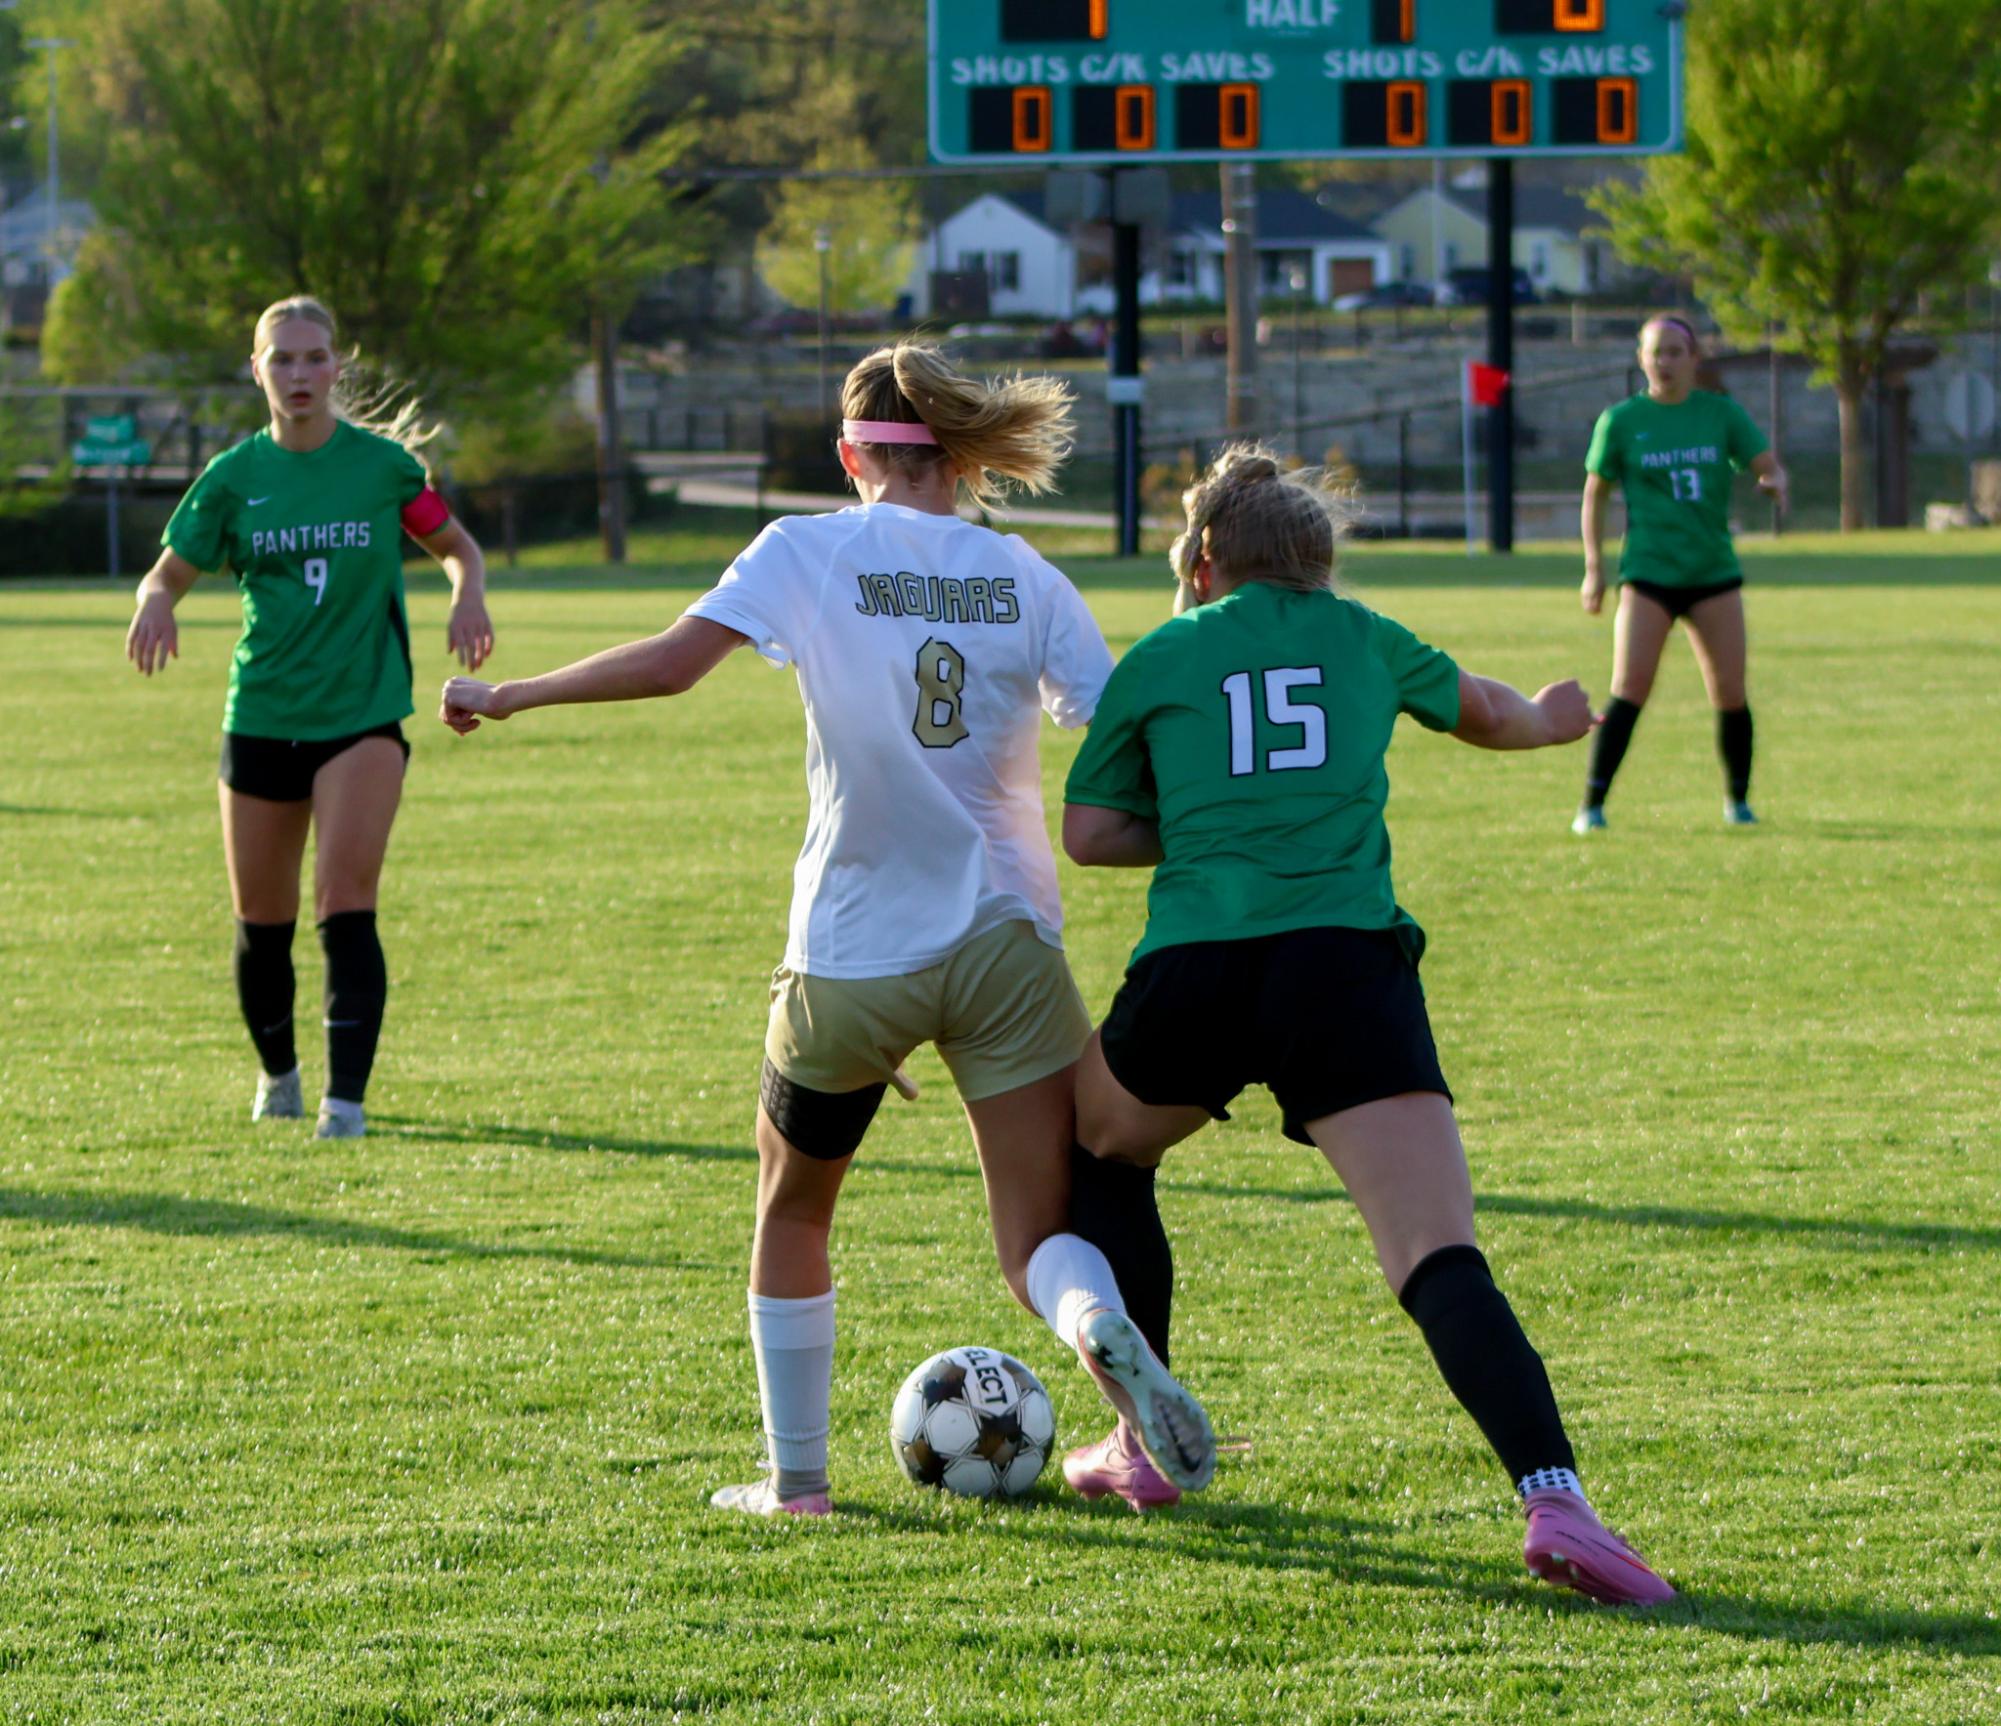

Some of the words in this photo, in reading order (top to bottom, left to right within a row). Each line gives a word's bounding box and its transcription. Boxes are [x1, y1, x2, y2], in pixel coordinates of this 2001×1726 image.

[1245, 0, 1340, 27] HALF
[951, 55, 1068, 84] SHOTS
[1161, 50, 1275, 81] SAVES
[1323, 46, 1442, 78] SHOTS
[1538, 45, 1655, 74] SAVES
[1013, 85, 1052, 151] 0
[1116, 84, 1154, 149] 0
[1219, 82, 1259, 148] 0
[1386, 80, 1427, 146] 0
[1491, 79, 1532, 145] 0
[1596, 77, 1638, 144] 0
[1670, 468, 1701, 500] 13
[252, 521, 371, 556] PANTHERS
[304, 558, 327, 607] 9
[855, 571, 1020, 623] JAGUARS
[912, 636, 970, 748] 8
[1220, 664, 1328, 777] 15
[964, 1347, 1008, 1404] ELECT
